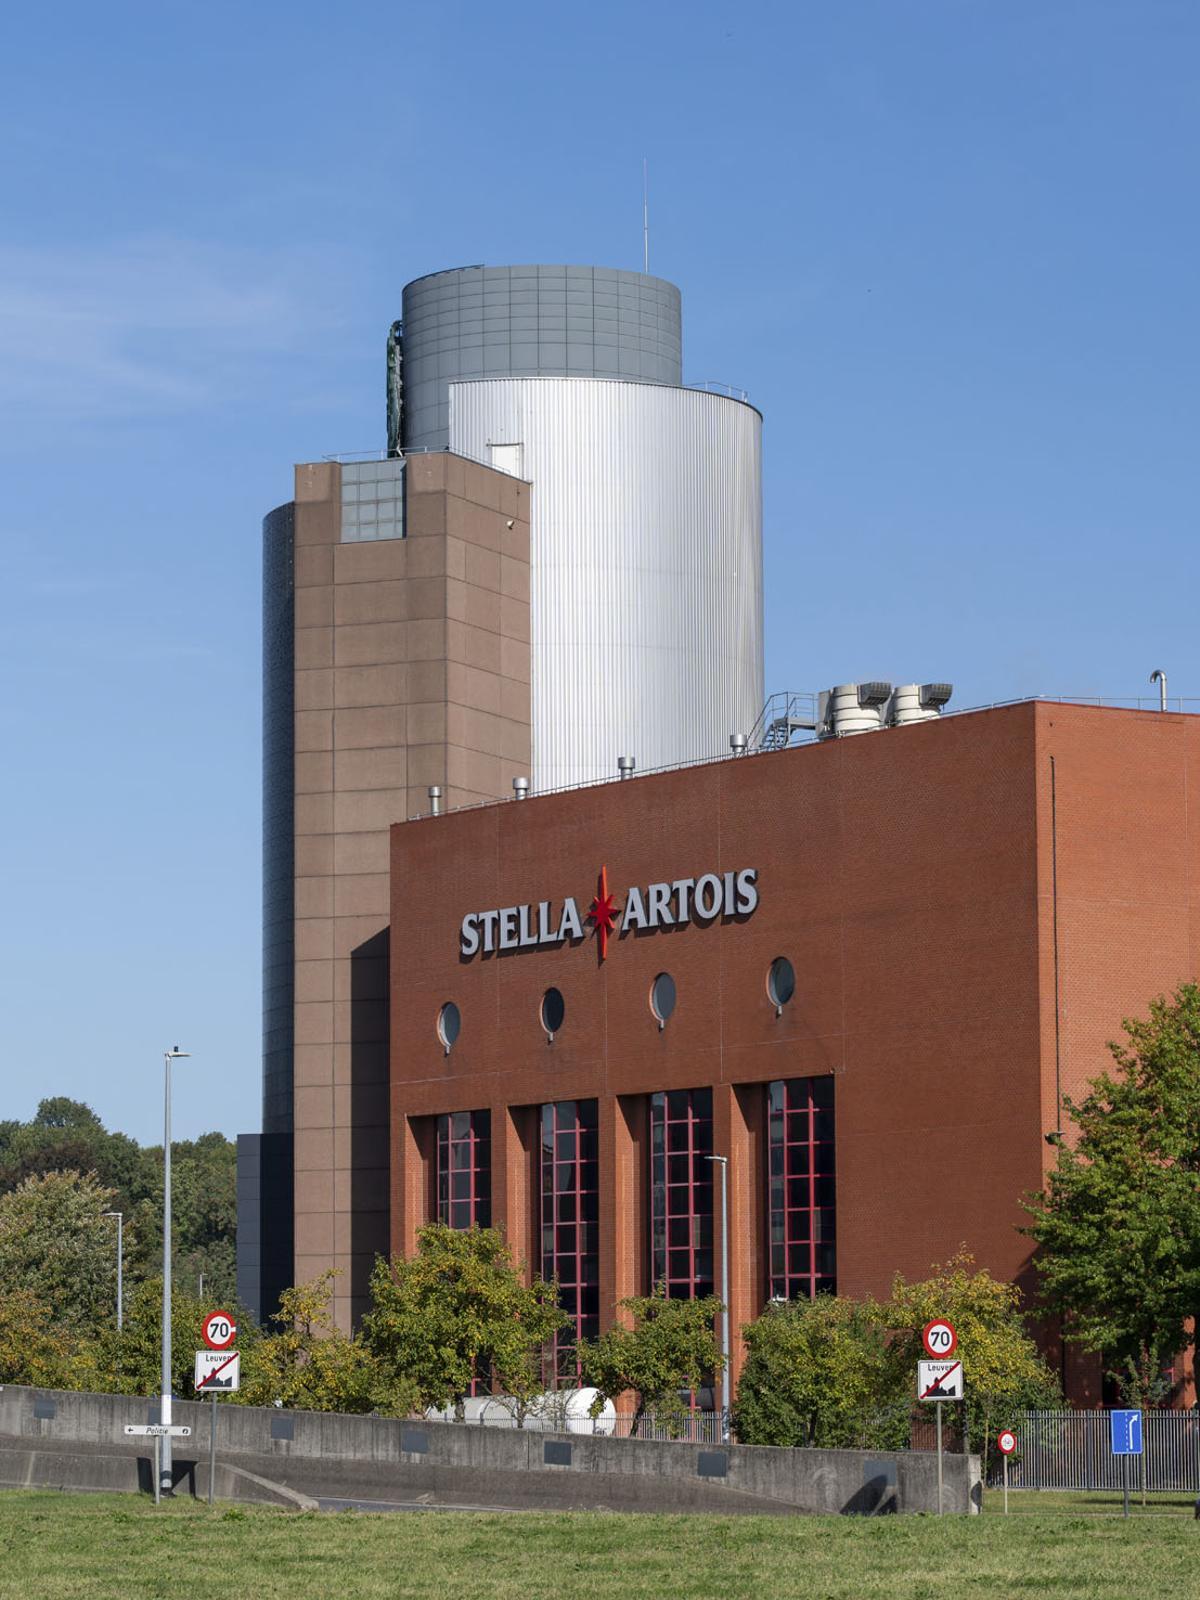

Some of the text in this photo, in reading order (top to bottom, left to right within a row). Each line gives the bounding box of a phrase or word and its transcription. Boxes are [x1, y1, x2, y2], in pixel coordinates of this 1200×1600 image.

[460, 868, 758, 955] STELLA ARTOIS
[210, 1322, 229, 1338] 70
[931, 1331, 950, 1347] 70
[205, 1354, 233, 1362] Leuven
